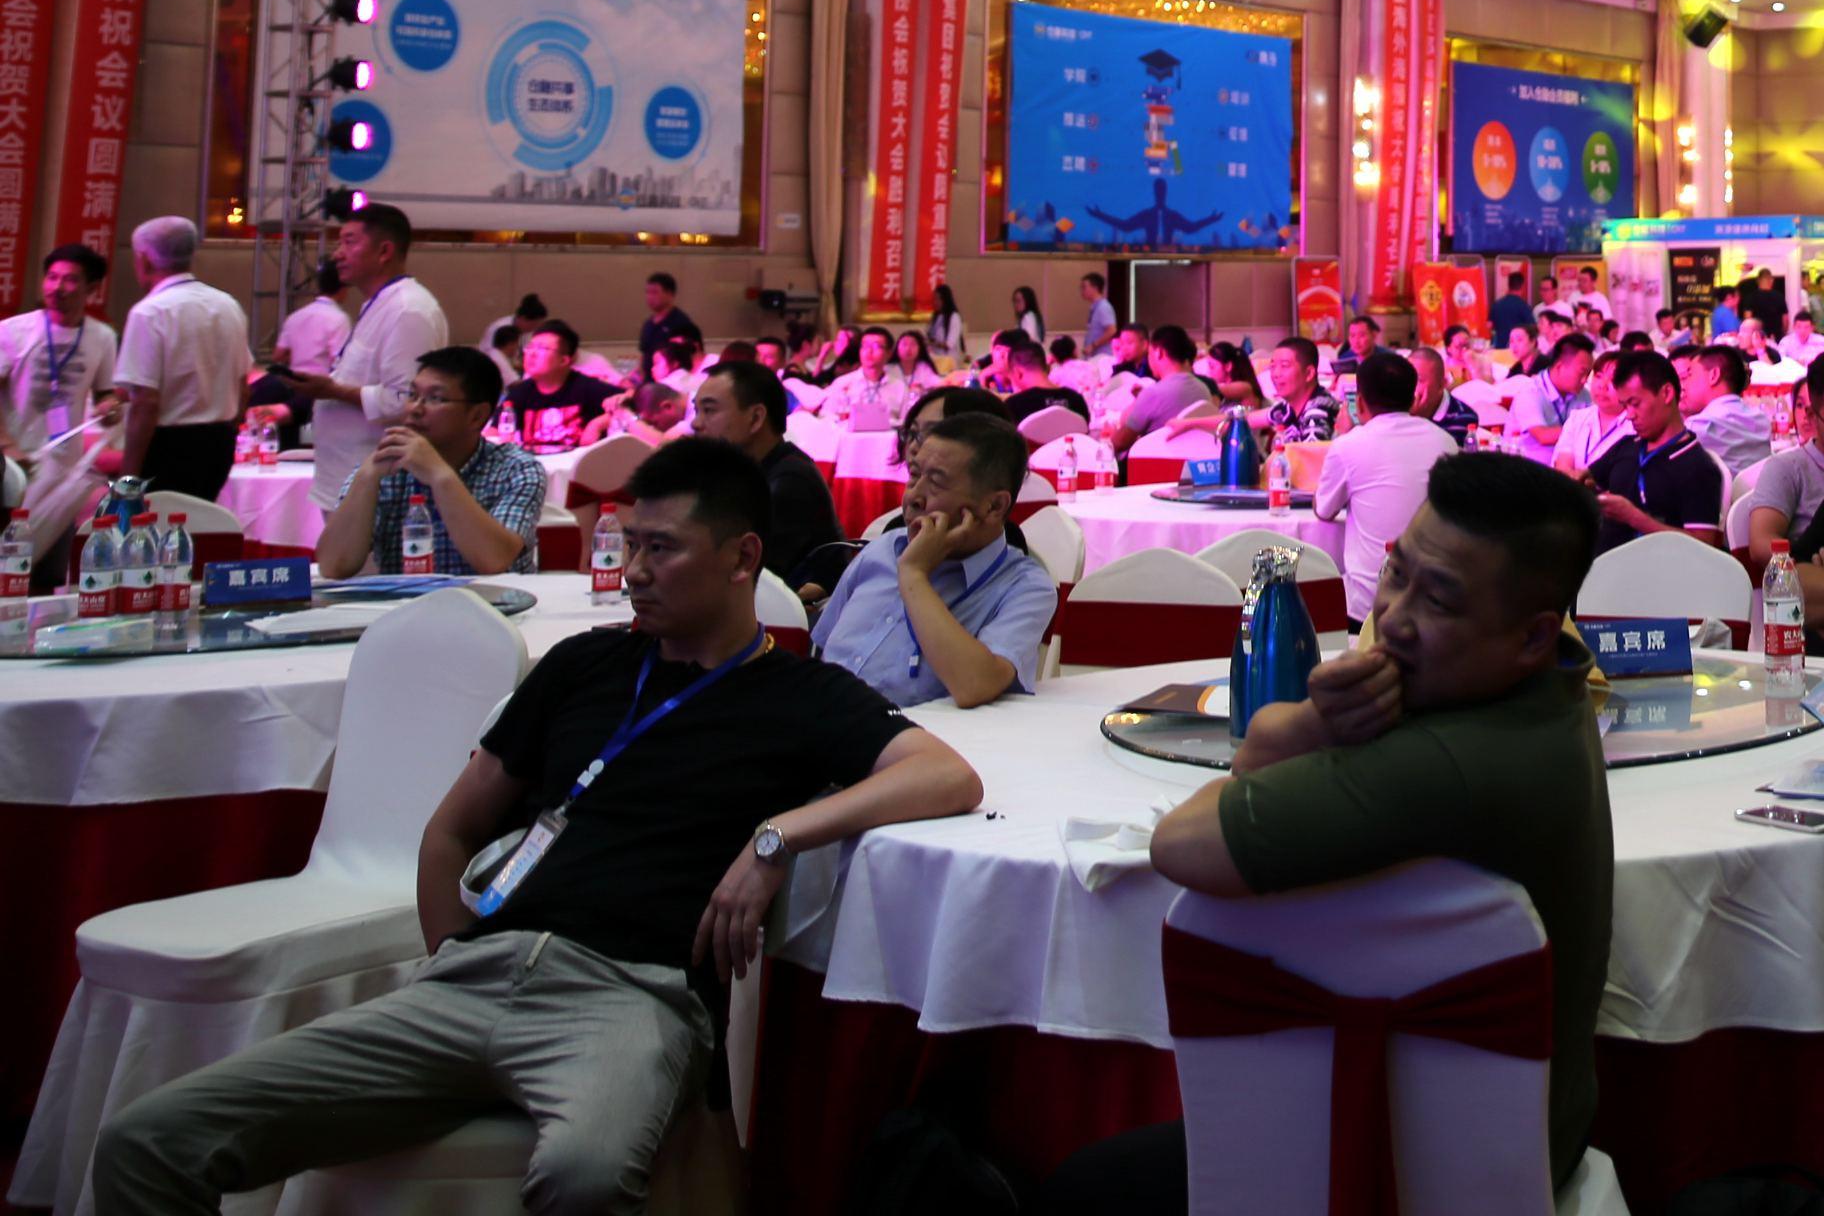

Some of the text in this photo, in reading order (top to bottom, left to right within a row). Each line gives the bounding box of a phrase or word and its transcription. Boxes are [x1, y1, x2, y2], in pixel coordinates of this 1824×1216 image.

[228, 567, 290, 586] 嘉宾席
[1598, 630, 1667, 653] 嘉宾席
